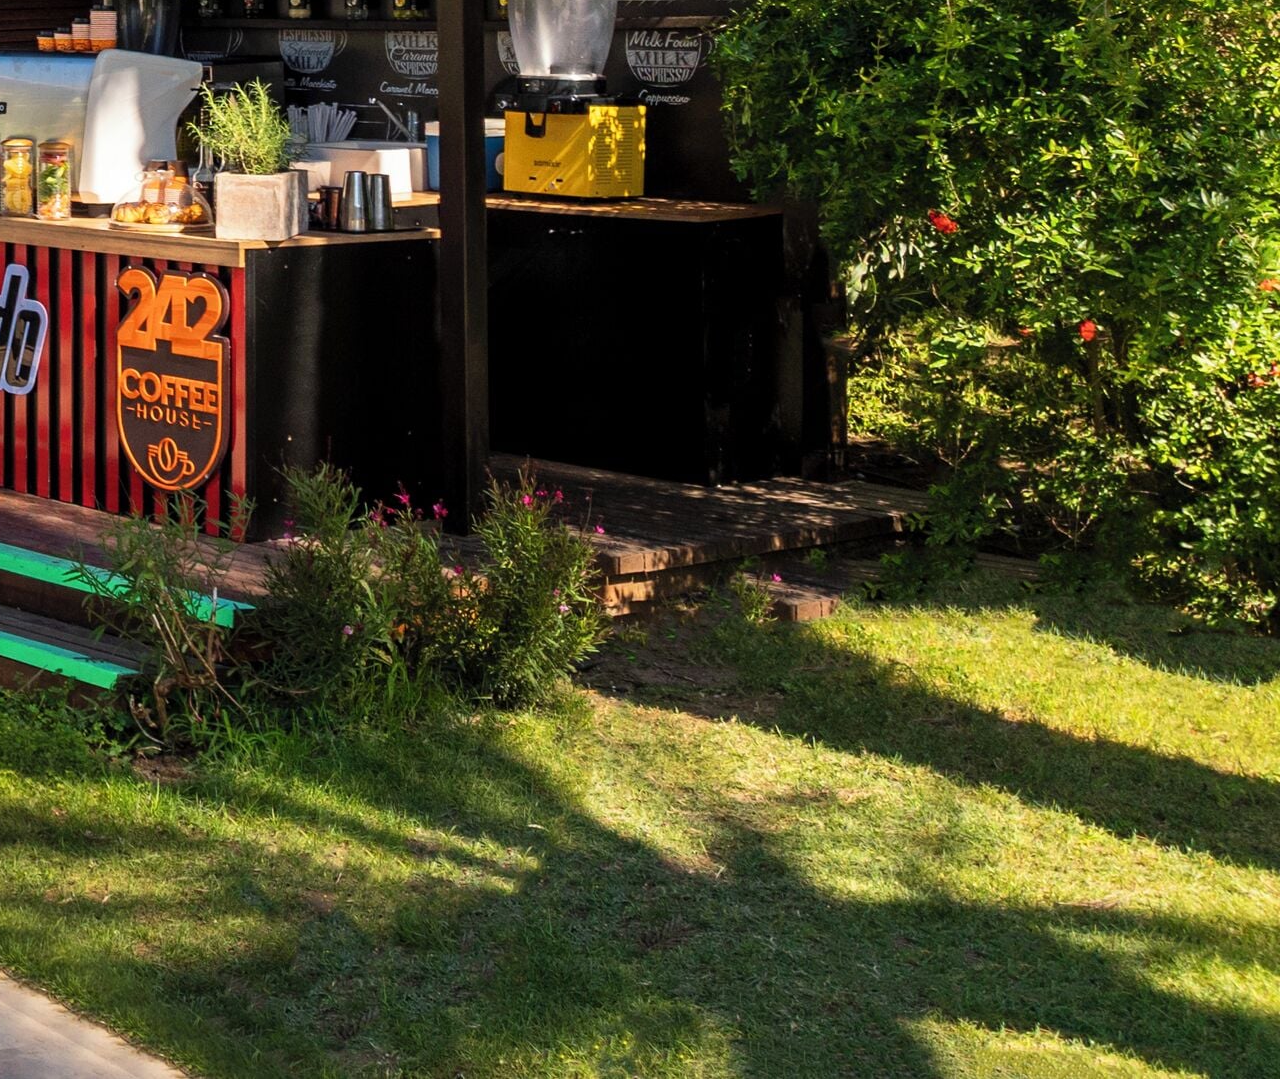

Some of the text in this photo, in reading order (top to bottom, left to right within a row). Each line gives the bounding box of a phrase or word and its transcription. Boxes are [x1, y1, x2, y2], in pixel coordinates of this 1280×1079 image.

[629, 31, 664, 49] Milk
[390, 45, 438, 62] Caramel
[634, 51, 690, 66] MILK
[284, 56, 328, 70] MILK
[636, 67, 690, 84] ESPRESSO
[638, 89, 691, 106] Cappuccino
[117, 269, 223, 362] 242
[120, 367, 219, 415] COFFEE
[136, 404, 202, 430] HOUSE
